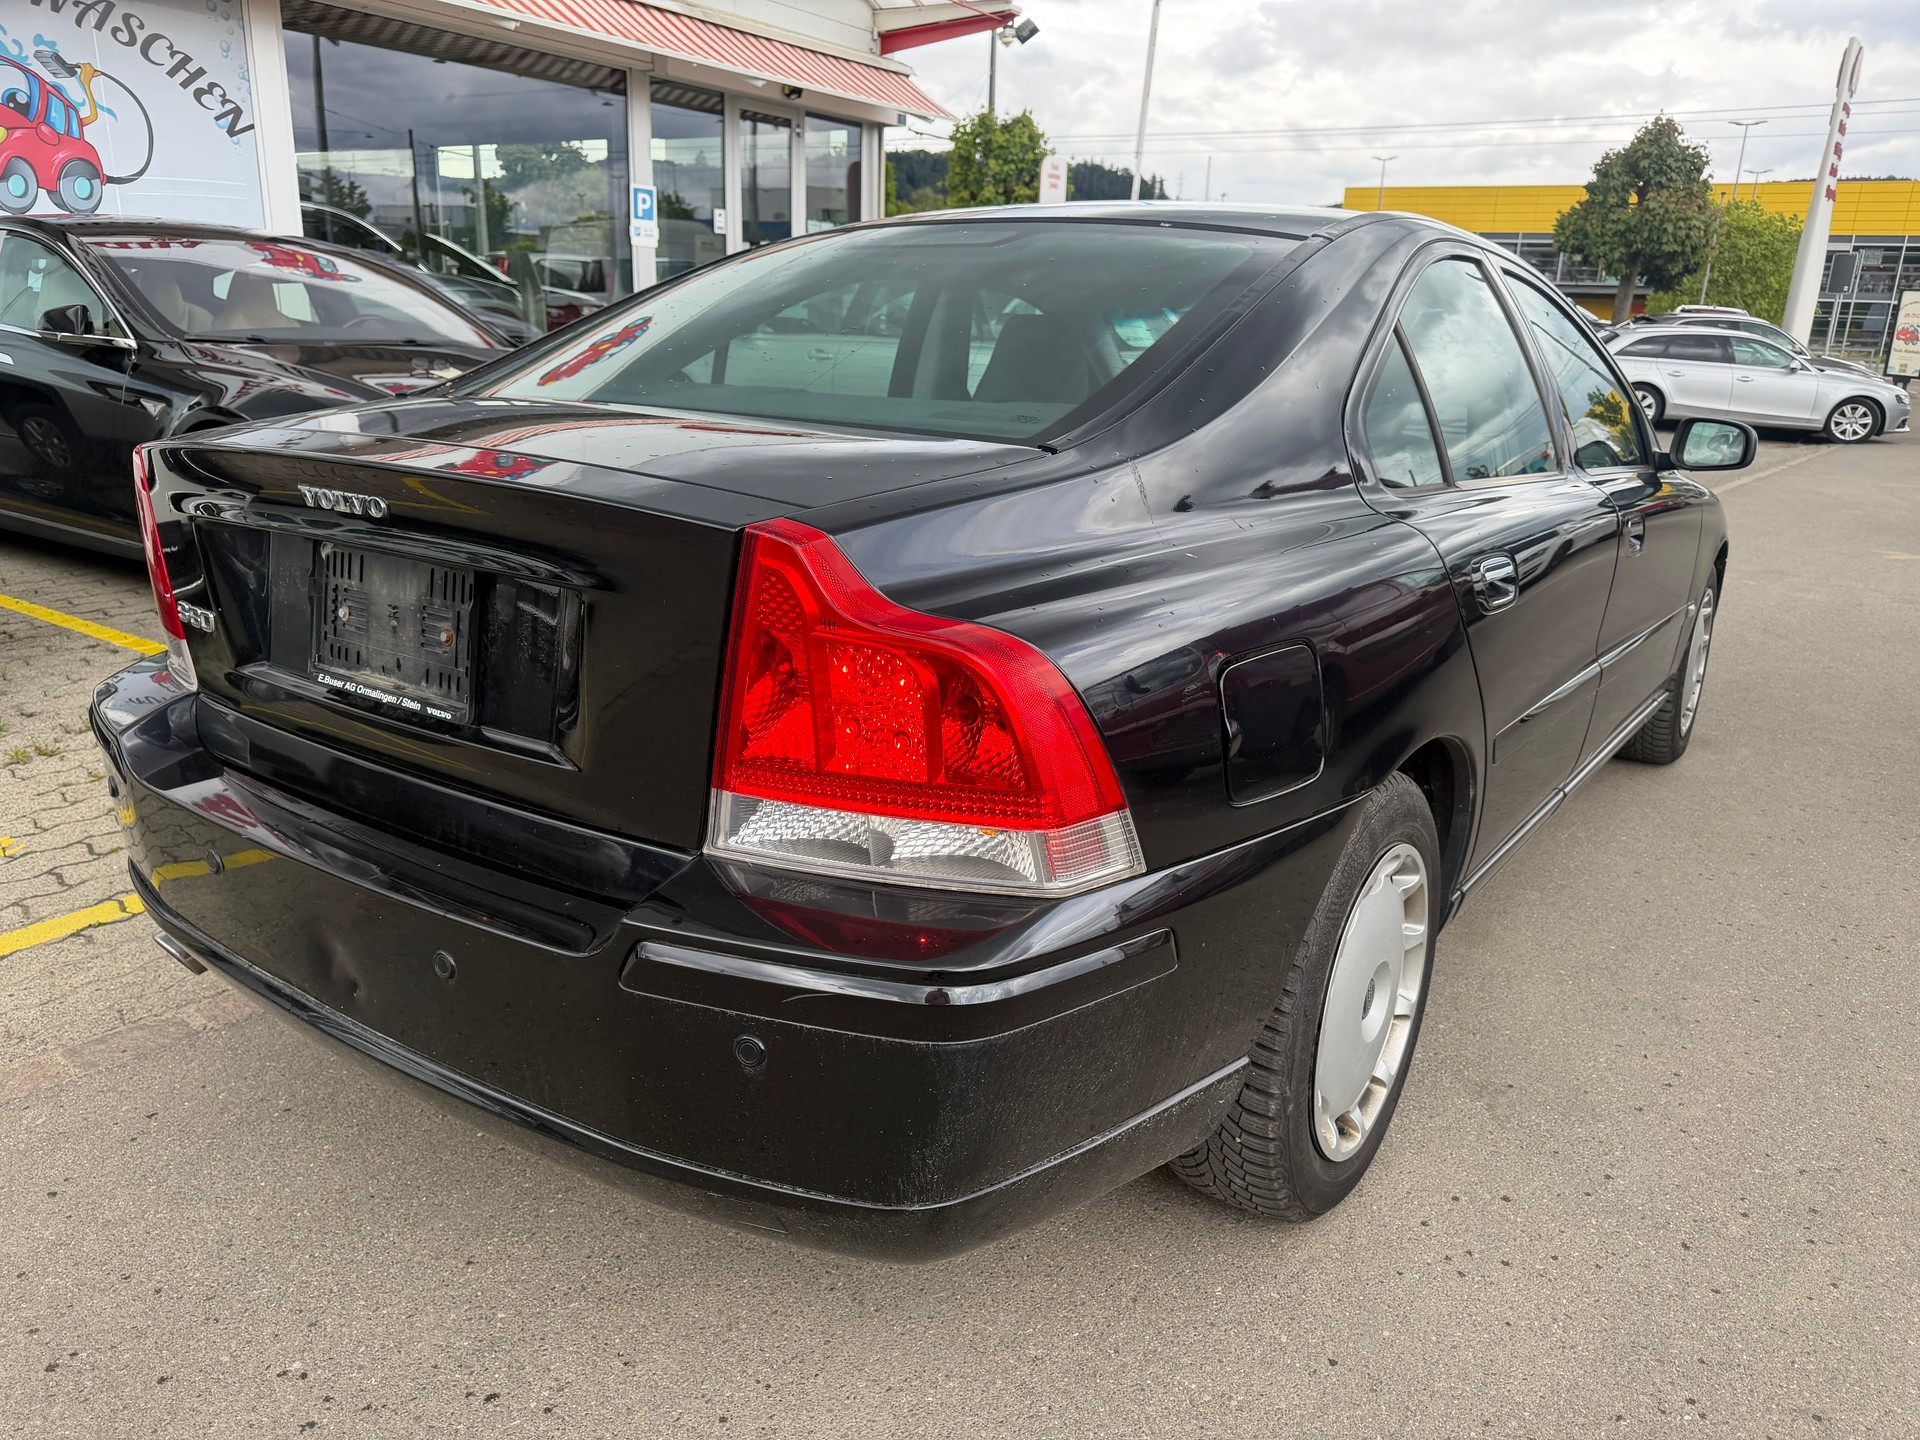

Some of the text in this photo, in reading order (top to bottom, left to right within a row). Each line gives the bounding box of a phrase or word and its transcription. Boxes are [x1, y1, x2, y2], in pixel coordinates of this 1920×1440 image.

[637, 192, 651, 217] P
[297, 484, 388, 518] VOLVO
[317, 674, 345, 688] E.Buser
[344, 682, 356, 691] AG
[356, 685, 397, 704] Ormalingen
[401, 697, 421, 710] Stein
[426, 706, 452, 719] VOLVO
